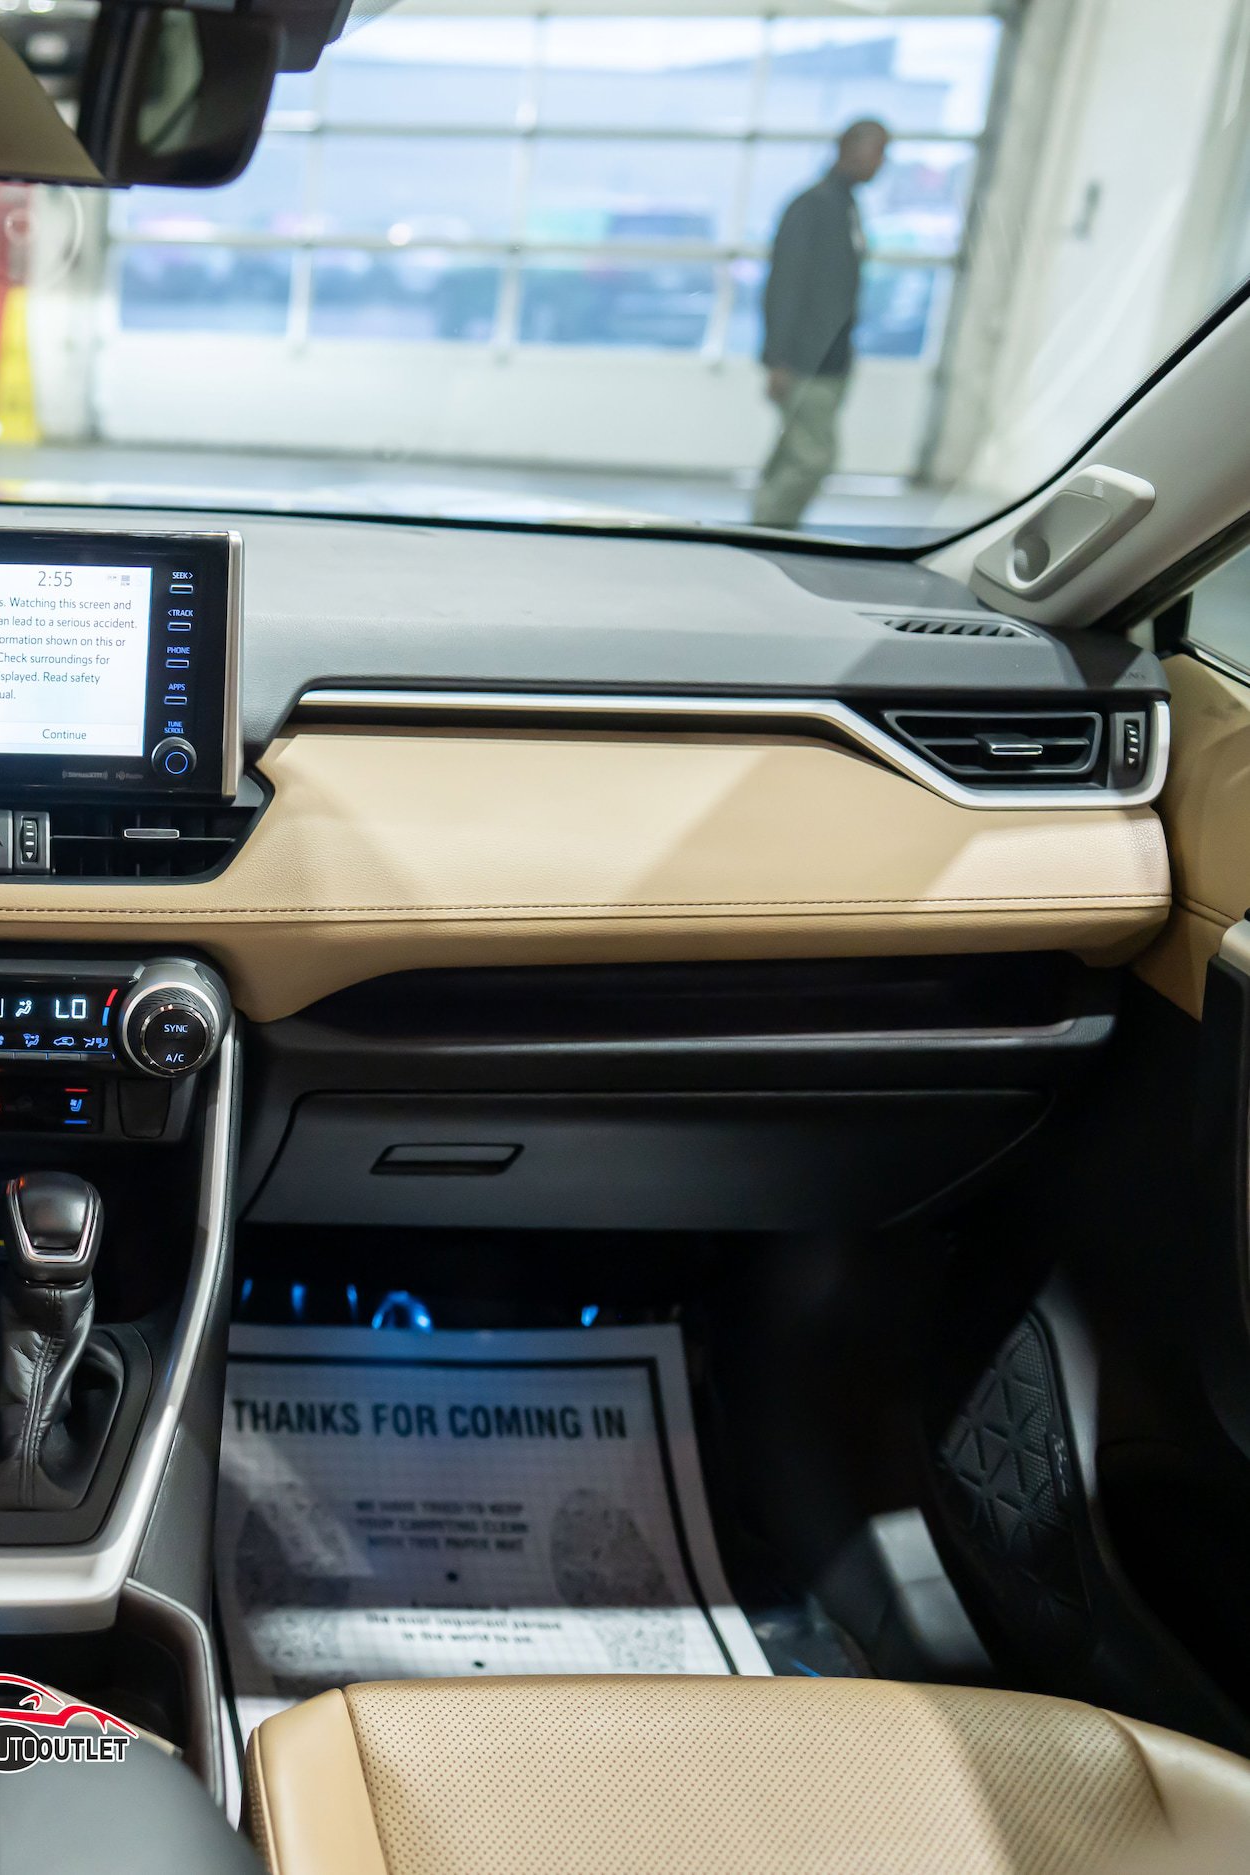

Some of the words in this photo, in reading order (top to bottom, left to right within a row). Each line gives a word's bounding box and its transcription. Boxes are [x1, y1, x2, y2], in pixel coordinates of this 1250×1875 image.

[38, 571, 73, 587] 2:55
[10, 597, 56, 610] Watching
[60, 598, 76, 609] this
[80, 602, 110, 610] screen
[114, 600, 132, 610] and
[12, 616, 32, 626] lead
[36, 618, 46, 627] to
[57, 618, 90, 628] serious
[94, 618, 138, 629] accident.
[46, 636, 78, 646] shown
[80, 638, 92, 646] on
[96, 636, 112, 646] this
[116, 638, 126, 646] or
[166, 646, 190, 654] PHONE
[30, 654, 92, 666] surroundings
[96, 654, 110, 665] for
[43, 672, 68, 682] Read
[70, 672, 100, 684] safety
[42, 728, 87, 741] Continue
[164, 1024, 188, 1033] SYNC
[166, 1054, 184, 1062] A/C
[232, 1399, 361, 1438] THANKS
[374, 1403, 438, 1438] FOR
[449, 1405, 581, 1440] COMING
[594, 1407, 628, 1440] IN
